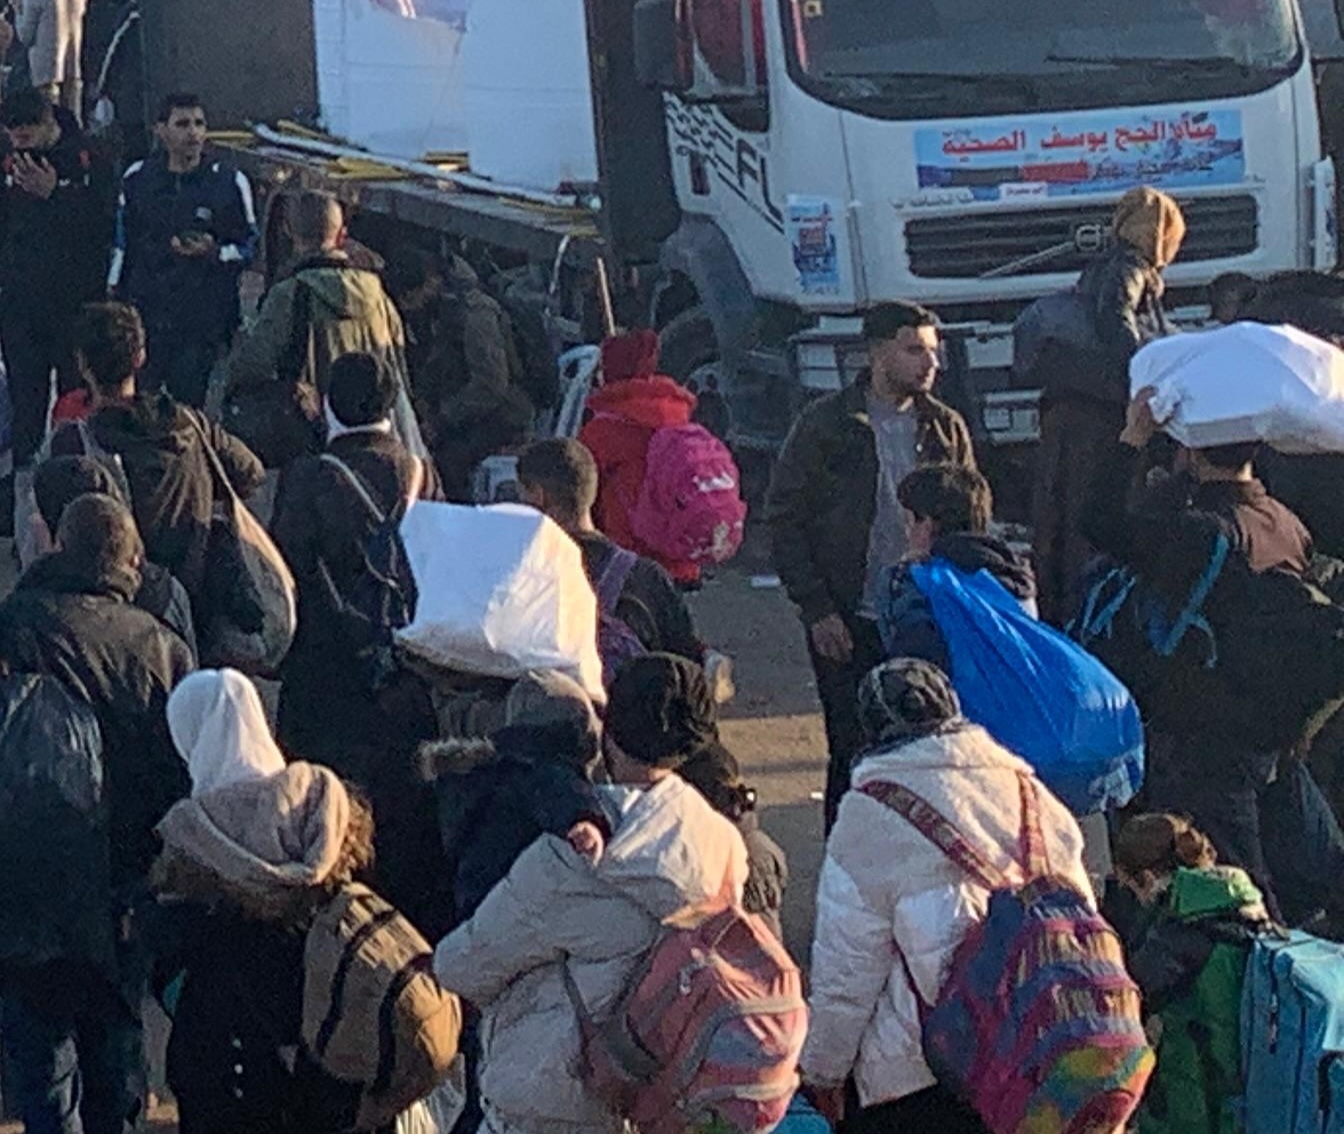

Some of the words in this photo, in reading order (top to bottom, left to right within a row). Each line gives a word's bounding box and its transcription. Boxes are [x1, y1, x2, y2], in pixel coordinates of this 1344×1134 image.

[942, 129, 1027, 162] الصحية
[1040, 125, 1108, 154] يوسف
[1115, 121, 1166, 152] الحج
